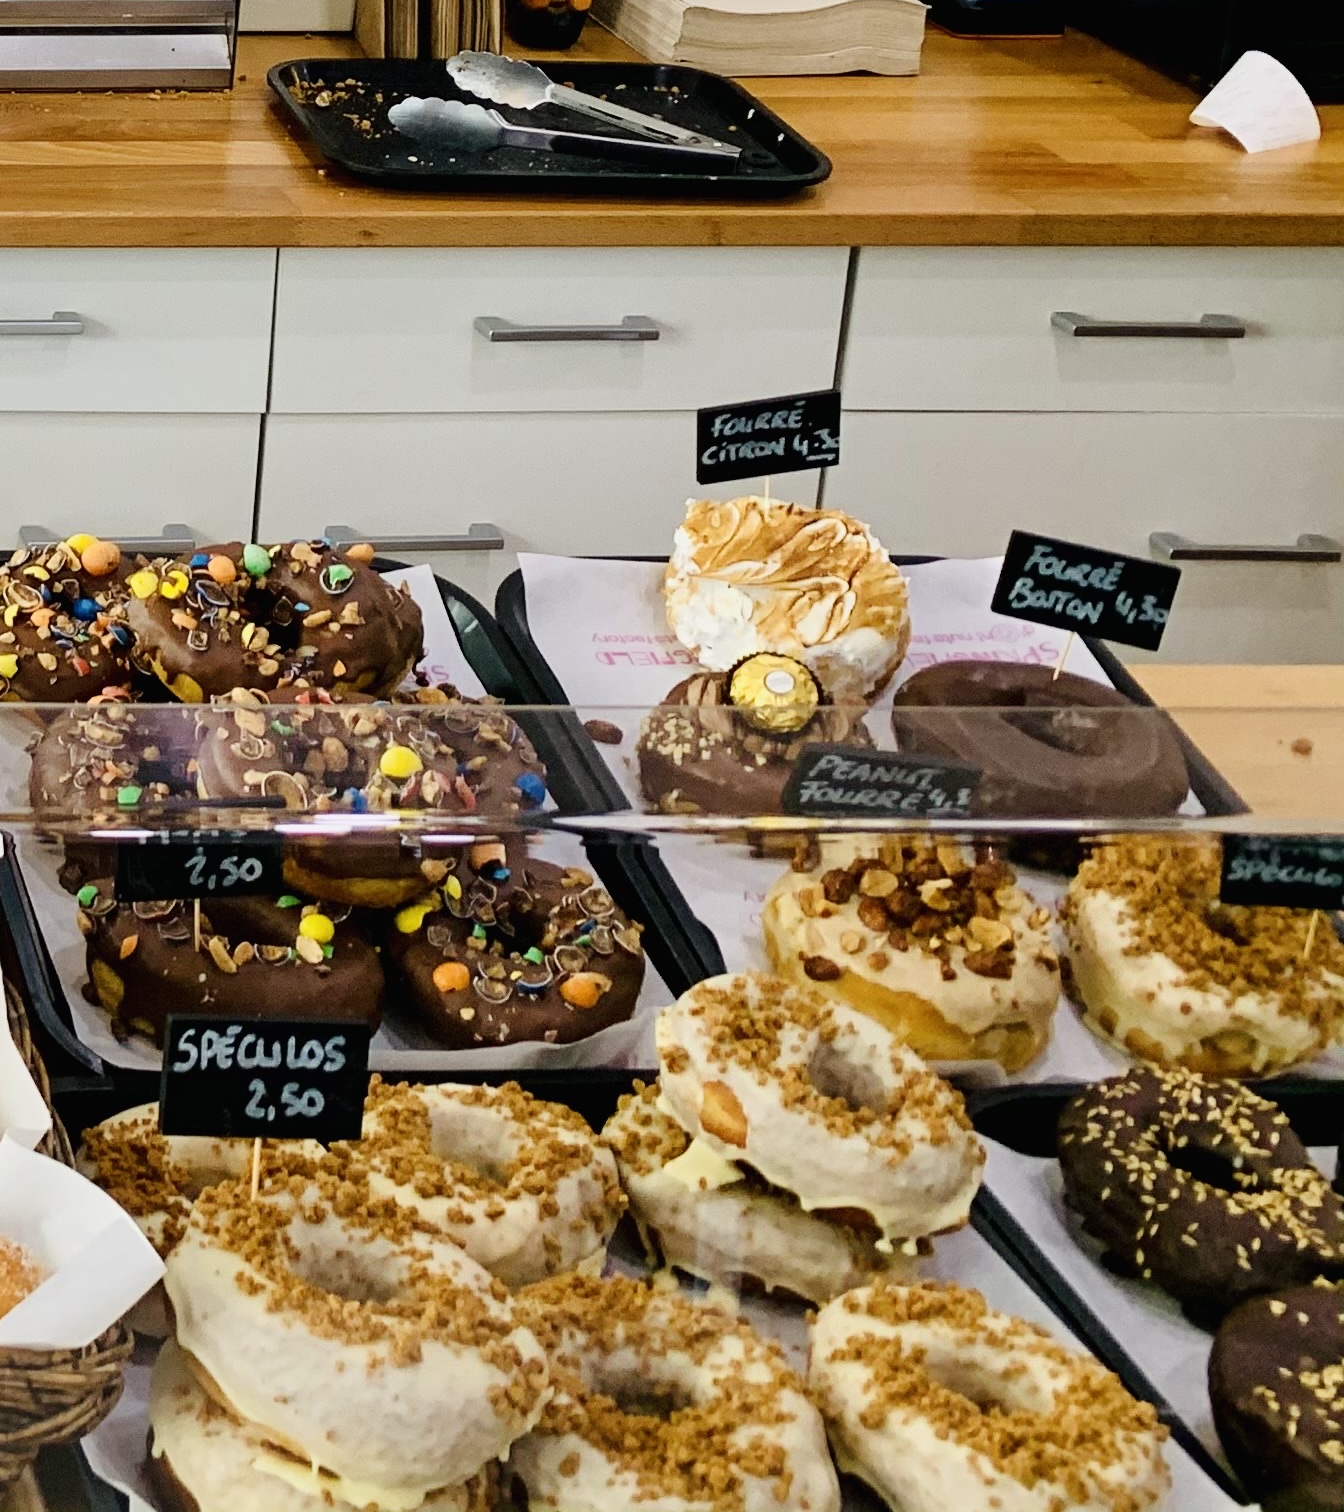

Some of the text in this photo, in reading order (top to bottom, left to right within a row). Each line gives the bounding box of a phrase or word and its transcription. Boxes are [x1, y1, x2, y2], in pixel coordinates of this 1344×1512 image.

[808, 754, 946, 791] PEANUT
[185, 846, 263, 890] 2,50
[172, 1024, 347, 1074] SPÉCULOS
[244, 1078, 326, 1123] 2,50
